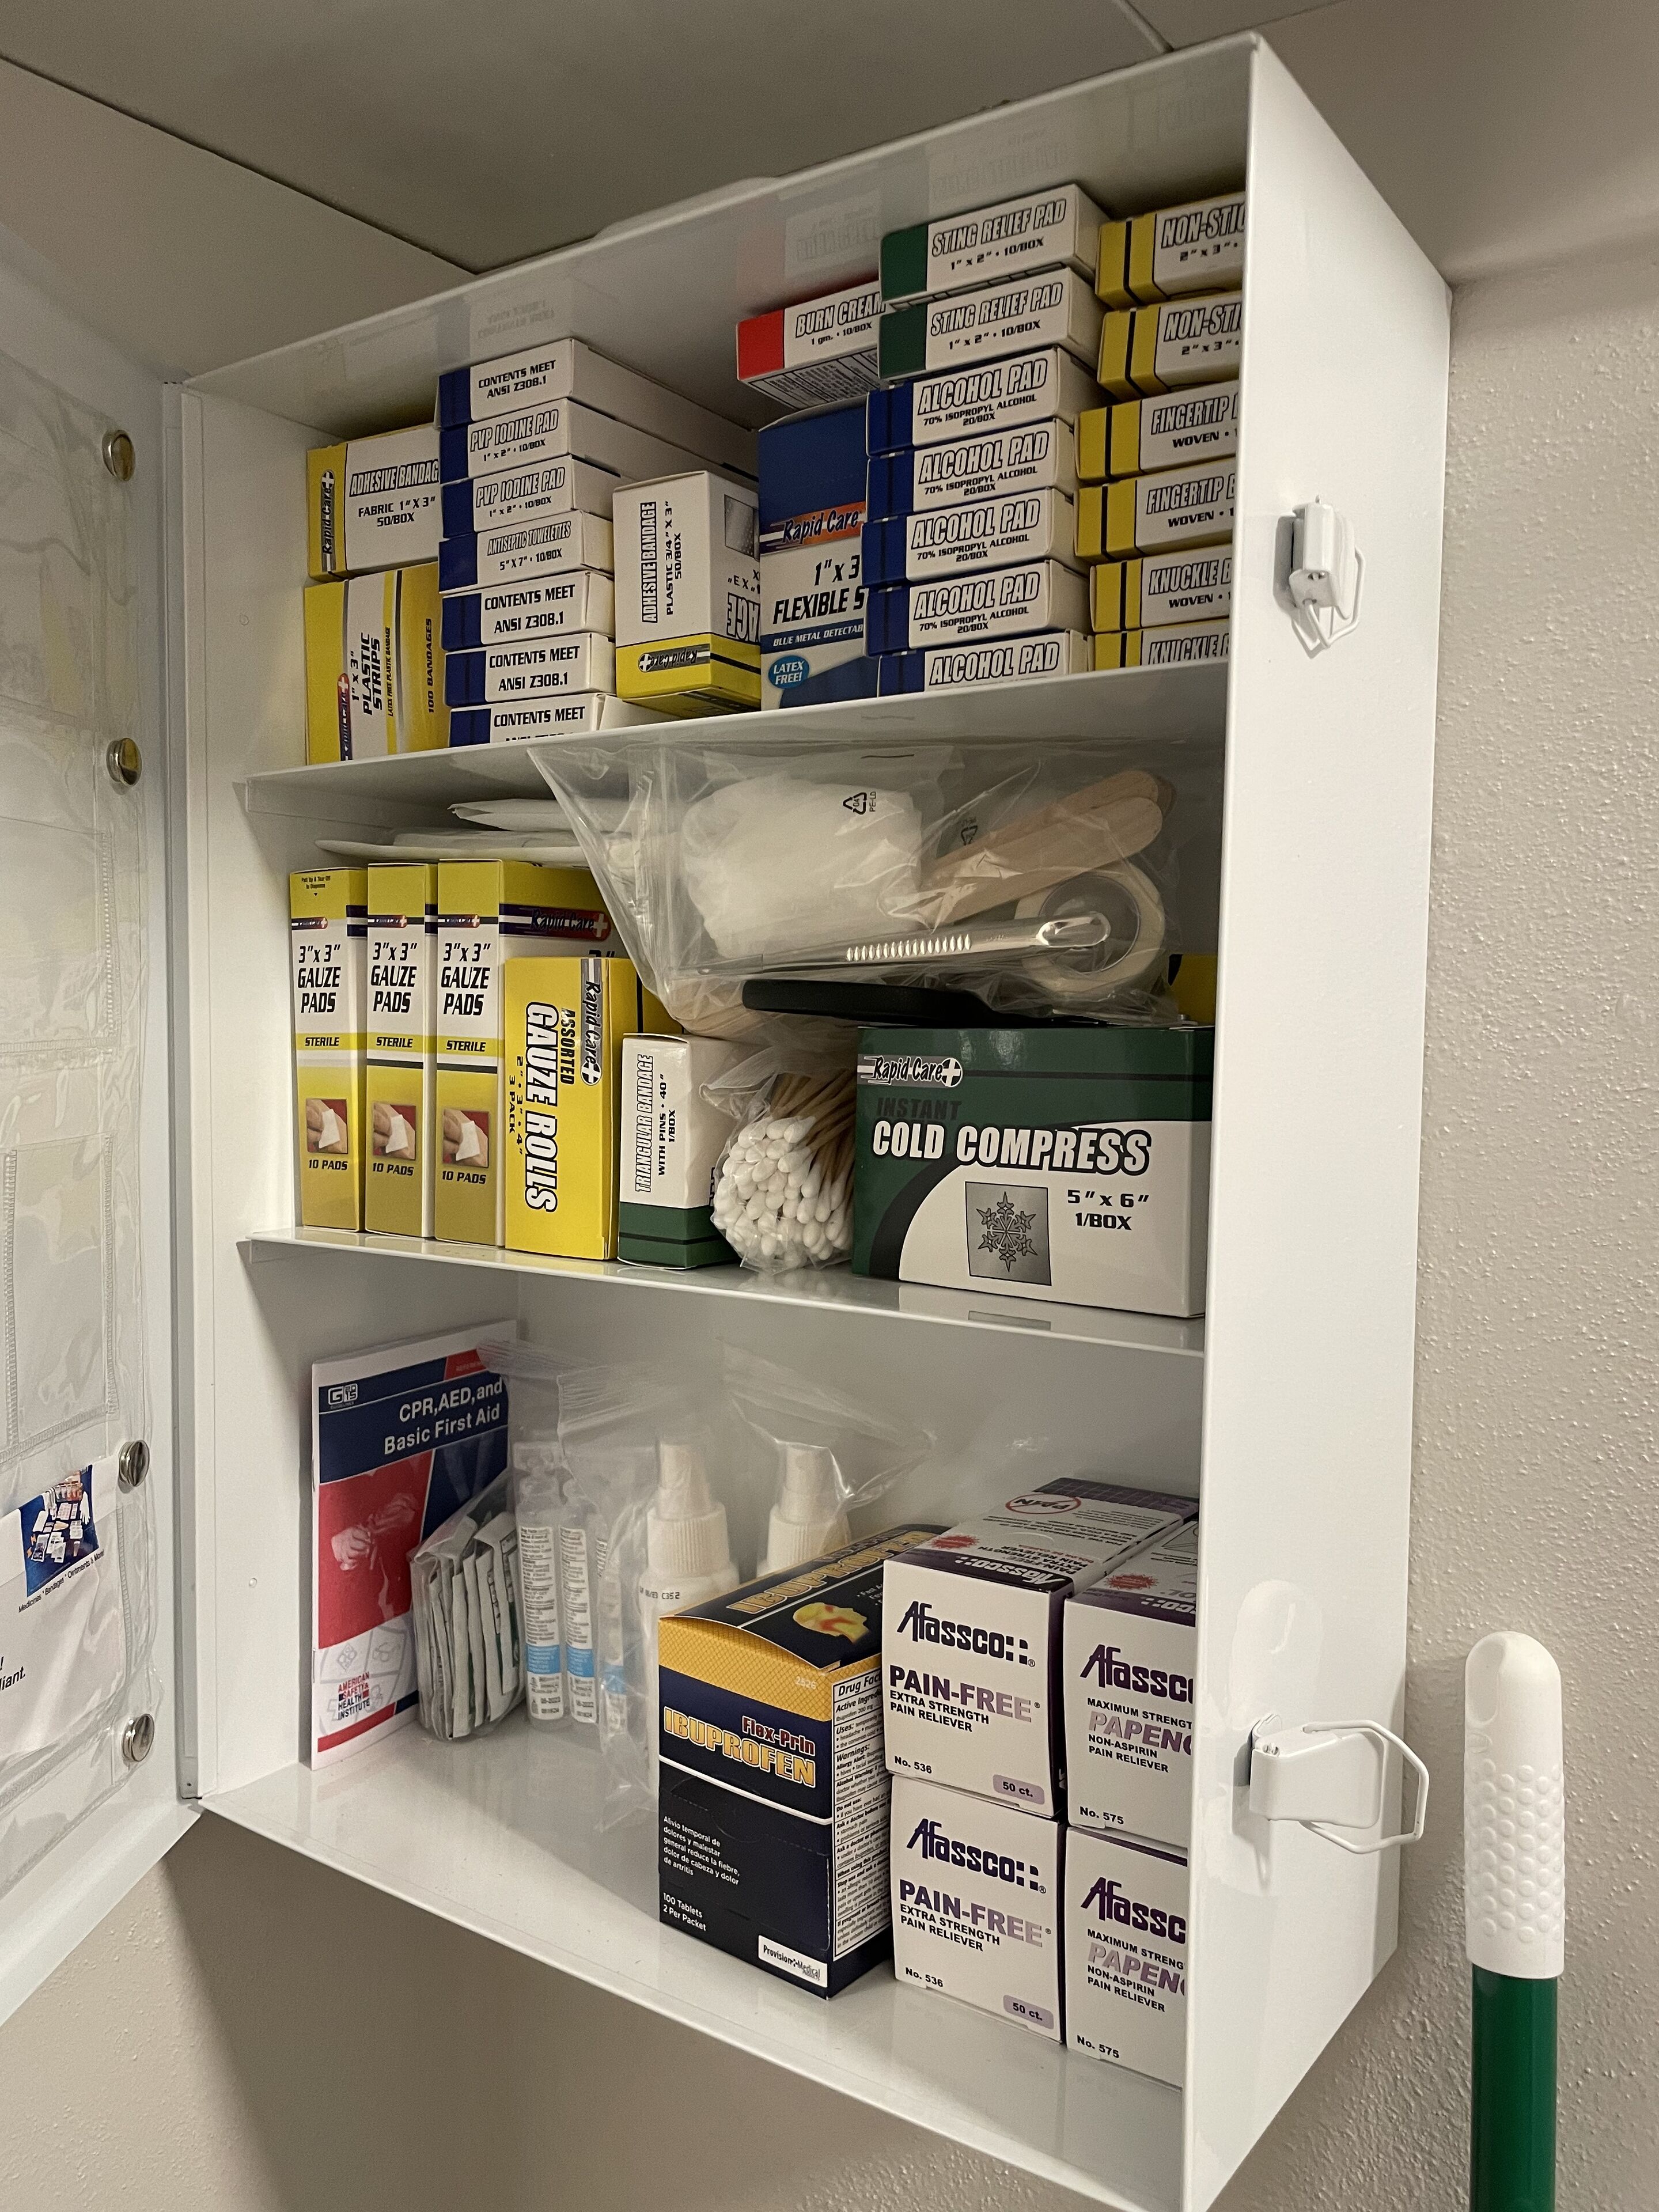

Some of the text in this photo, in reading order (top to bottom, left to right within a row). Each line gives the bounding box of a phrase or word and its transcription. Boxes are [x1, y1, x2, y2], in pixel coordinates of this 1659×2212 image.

[931, 199, 1066, 257] STING RELIEF PAD
[1161, 202, 1245, 249] NON-STI
[1004, 237, 1044, 255] 10/BOX
[795, 292, 885, 338] BURN CREAM
[843, 321, 872, 335] 10/BOX
[479, 360, 556, 389] CONTENTS MEET
[487, 375, 547, 398] ANSI Z308.1
[918, 358, 1048, 415] ALCOHOL PAD
[923, 394, 1036, 426] 70% ISOPROPYL ALCOHOL
[963, 413, 995, 426] 20/BOX
[1151, 396, 1229, 435] FINGERTIP
[470, 409, 559, 452] PVP IODINE PAD
[1172, 431, 1219, 448] WOVEN
[519, 439, 546, 452] 10/BOX
[350, 459, 440, 497] ADHESIVE BANDAG
[321, 488, 334, 554] Rapid Care
[358, 502, 394, 517] FABRIC
[377, 512, 415, 527] 50/BOX
[487, 521, 571, 556] ANTISEPTIC TOWELETTES
[782, 510, 859, 544] Rapid Care
[536, 548, 562, 562] 10/BOX
[640, 501, 657, 623] ADHESIVE BANDAGE
[1149, 559, 1219, 595] KNUCKLE
[484, 584, 575, 610] CONTENTS MEET
[773, 588, 849, 624] FLEXIBLE
[1169, 593, 1213, 608] WOVEN
[494, 611, 564, 634] ANSI Z308.1
[773, 624, 863, 646] BLUE METAL DETECTAB
[361, 632, 373, 715] PLASTIC
[371, 638, 382, 710] STRIPS
[773, 660, 803, 675] LATEX
[775, 672, 802, 685] FREE!
[298, 967, 341, 988] GAUZE
[441, 967, 490, 989] GAUZE
[301, 992, 336, 1013] PADS
[444, 993, 484, 1016] PADS
[582, 980, 601, 1065] Rapid Care
[305, 1037, 339, 1047] STERILE
[446, 1040, 486, 1052] STERILE
[560, 1008, 575, 1085] ASSORTED
[873, 1056, 943, 1081] Rapid Care
[525, 1001, 559, 1212] GAUZE ROLLS
[877, 1097, 962, 1121] INSTANT
[635, 1054, 653, 1192] TRIANGULAR BANDAGE
[873, 1120, 1152, 1176] COLD COMPRESS
[309, 1160, 348, 1171] 10 PADS
[1067, 1189, 1149, 1207] 5" 6"
[1075, 1212, 1132, 1230] 1/BOX
[384, 1403, 499, 1455] Basic First Aid
[67, 1560, 90, 1578] Ointments
[973, 1560, 1065, 1584] Afassco
[897, 1601, 1004, 1660] Afassco
[338, 1671, 369, 1694] AMERICAN
[839, 1672, 881, 1696] Drug Fac
[889, 1665, 1032, 1722] PAIN-FREE
[338, 1693, 361, 1710] HEALTH
[338, 1698, 370, 1720] INSTITUTE
[836, 1690, 882, 1713] Active Ingredi
[890, 1691, 989, 1725] EXTRA STRENGTH
[1088, 1698, 1192, 1730] MAXIMUM STRENGT
[836, 1724, 854, 1734] Uses:
[891, 1702, 972, 1732] PAIN RELIEVER
[742, 1715, 815, 1756] Flex-Prin
[1089, 1711, 1191, 1755] PAPEN
[664, 1706, 815, 1788] IBUPROFEN
[836, 1744, 870, 1762] Warnings:
[1089, 1734, 1157, 1758] NON-ASPIRIN
[895, 1756, 932, 1774] No. 536
[1002, 1782, 1033, 1797] 50 ct.
[1080, 1806, 1124, 1824] No. 575
[664, 1816, 720, 1847] Alivio temporal de
[664, 1827, 720, 1857] dolores malestar
[664, 1837, 740, 1877] general reduce la fiebre,
[664, 1847, 738, 1885] dolor de cabeza dolor
[664, 1857, 694, 1875] de artritis
[663, 1904, 706, 1931] 2 Per Packet
[664, 1893, 702, 1918] 100 Tablets
[764, 1945, 793, 1964] Provision
[798, 1960, 820, 1978] Medical
